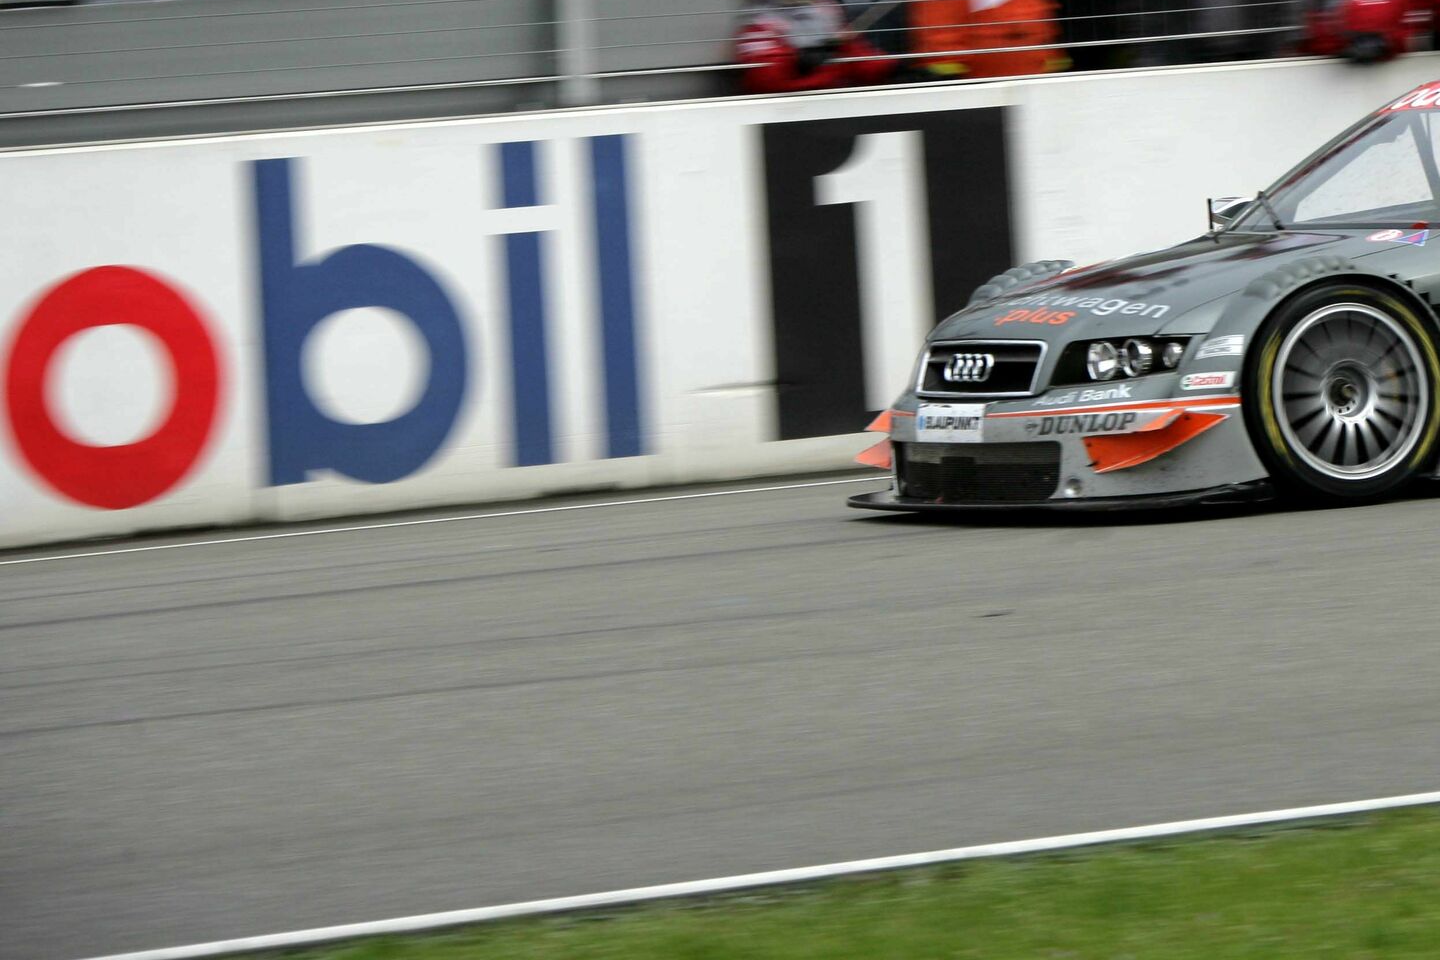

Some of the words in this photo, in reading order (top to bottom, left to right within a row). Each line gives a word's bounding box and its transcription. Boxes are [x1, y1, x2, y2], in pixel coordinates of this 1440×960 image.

[1033, 389, 1074, 407] Audi
[1079, 383, 1133, 402] Bank
[1038, 411, 1137, 435] DUNLOP
